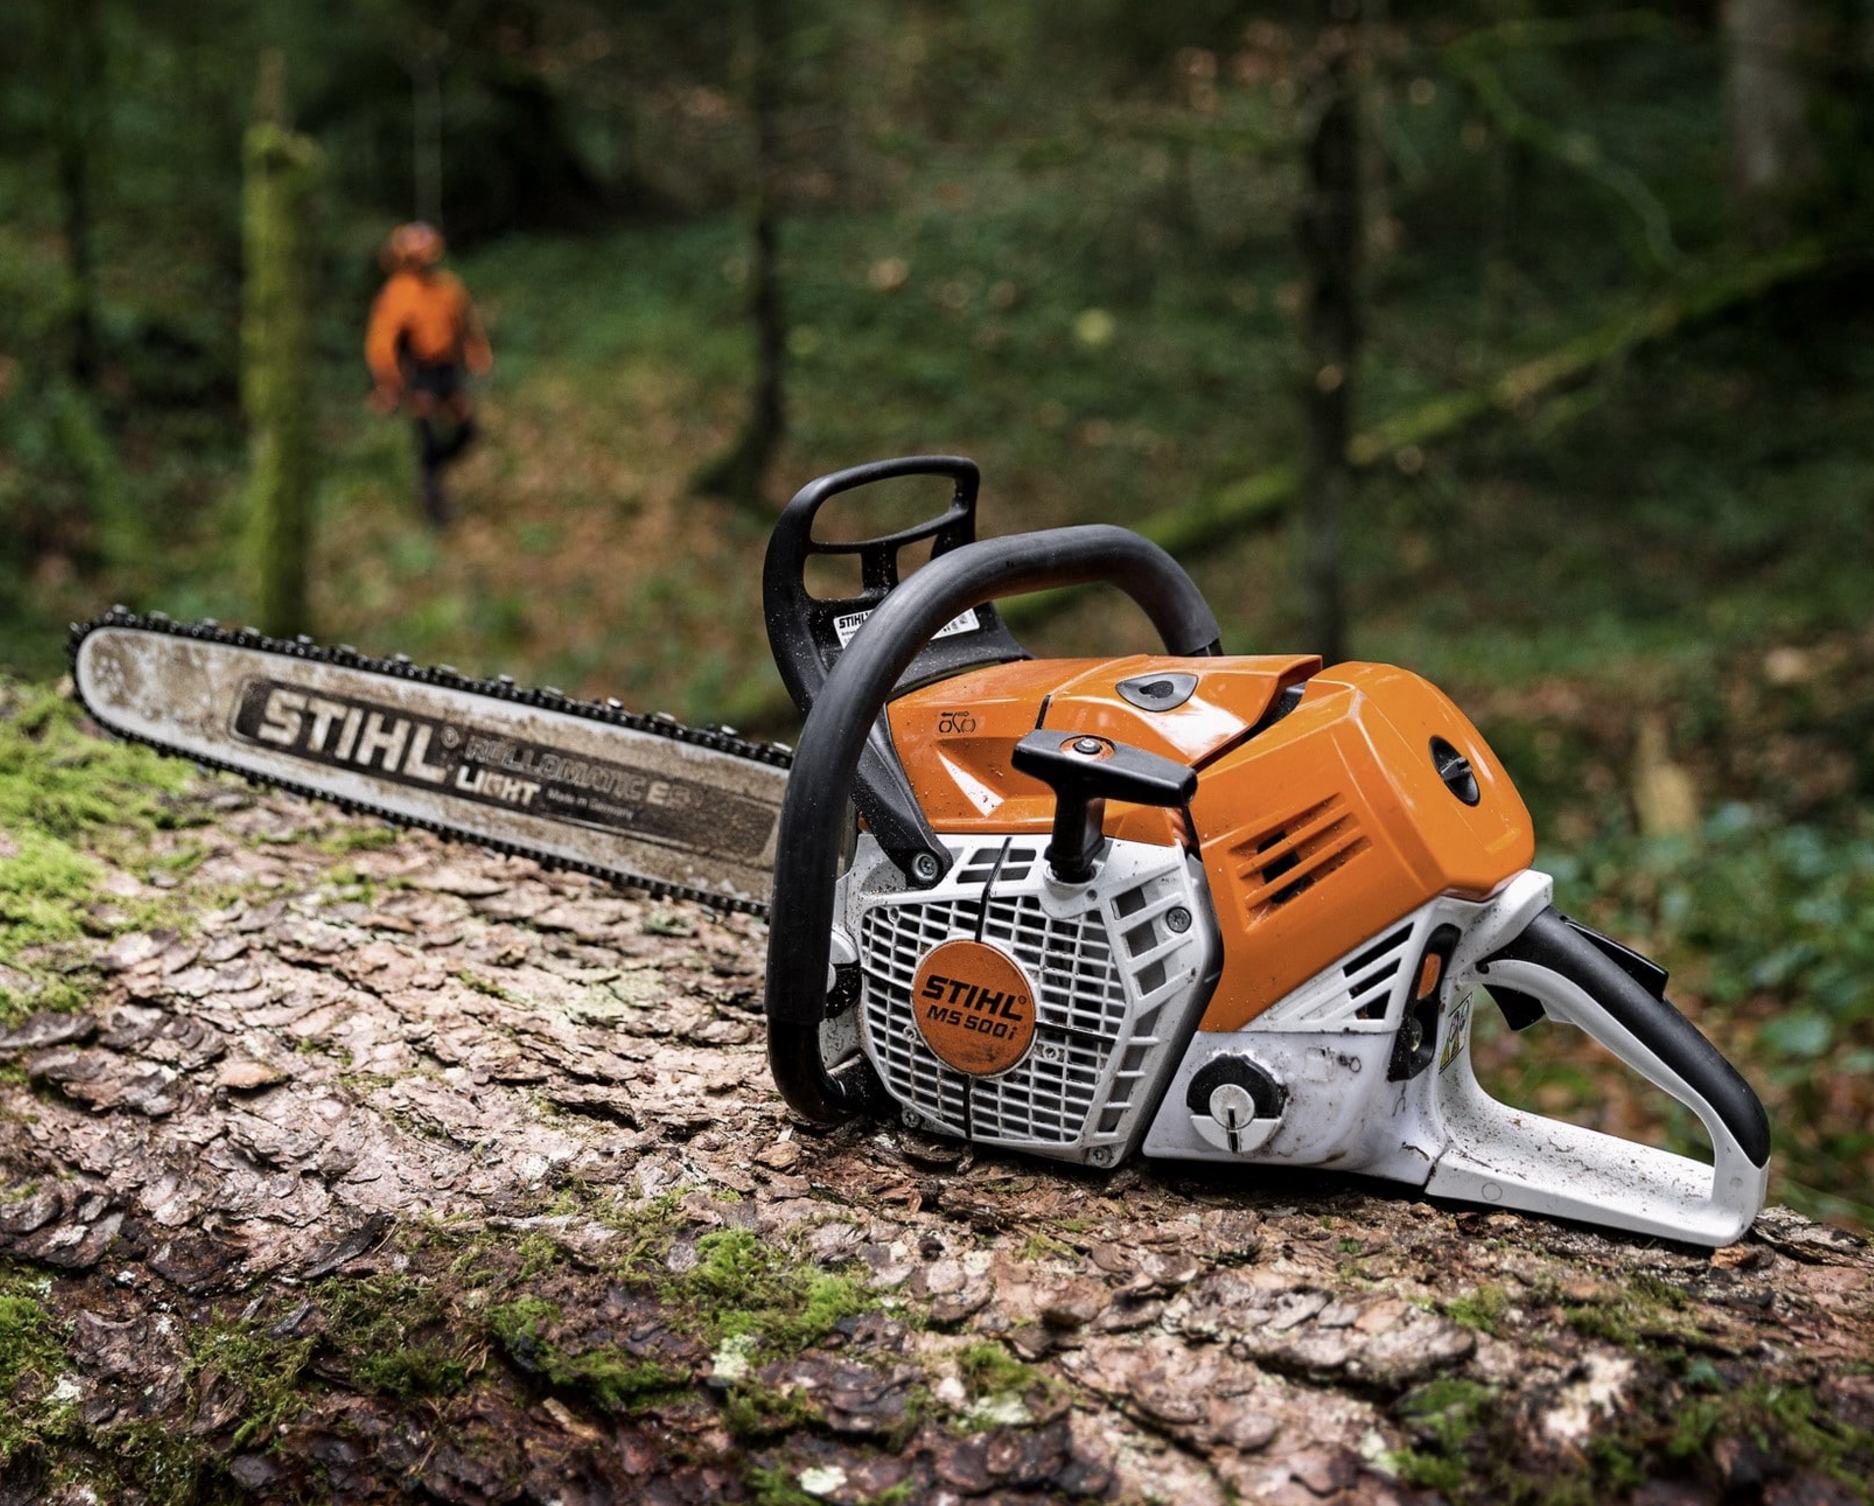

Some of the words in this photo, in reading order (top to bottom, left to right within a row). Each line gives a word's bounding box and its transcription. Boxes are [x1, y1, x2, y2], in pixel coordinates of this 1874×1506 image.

[258, 688, 448, 784] STIHL
[455, 764, 542, 806] LIGHT
[922, 974, 1023, 1022] STIHL
[926, 1005, 963, 1026] MS
